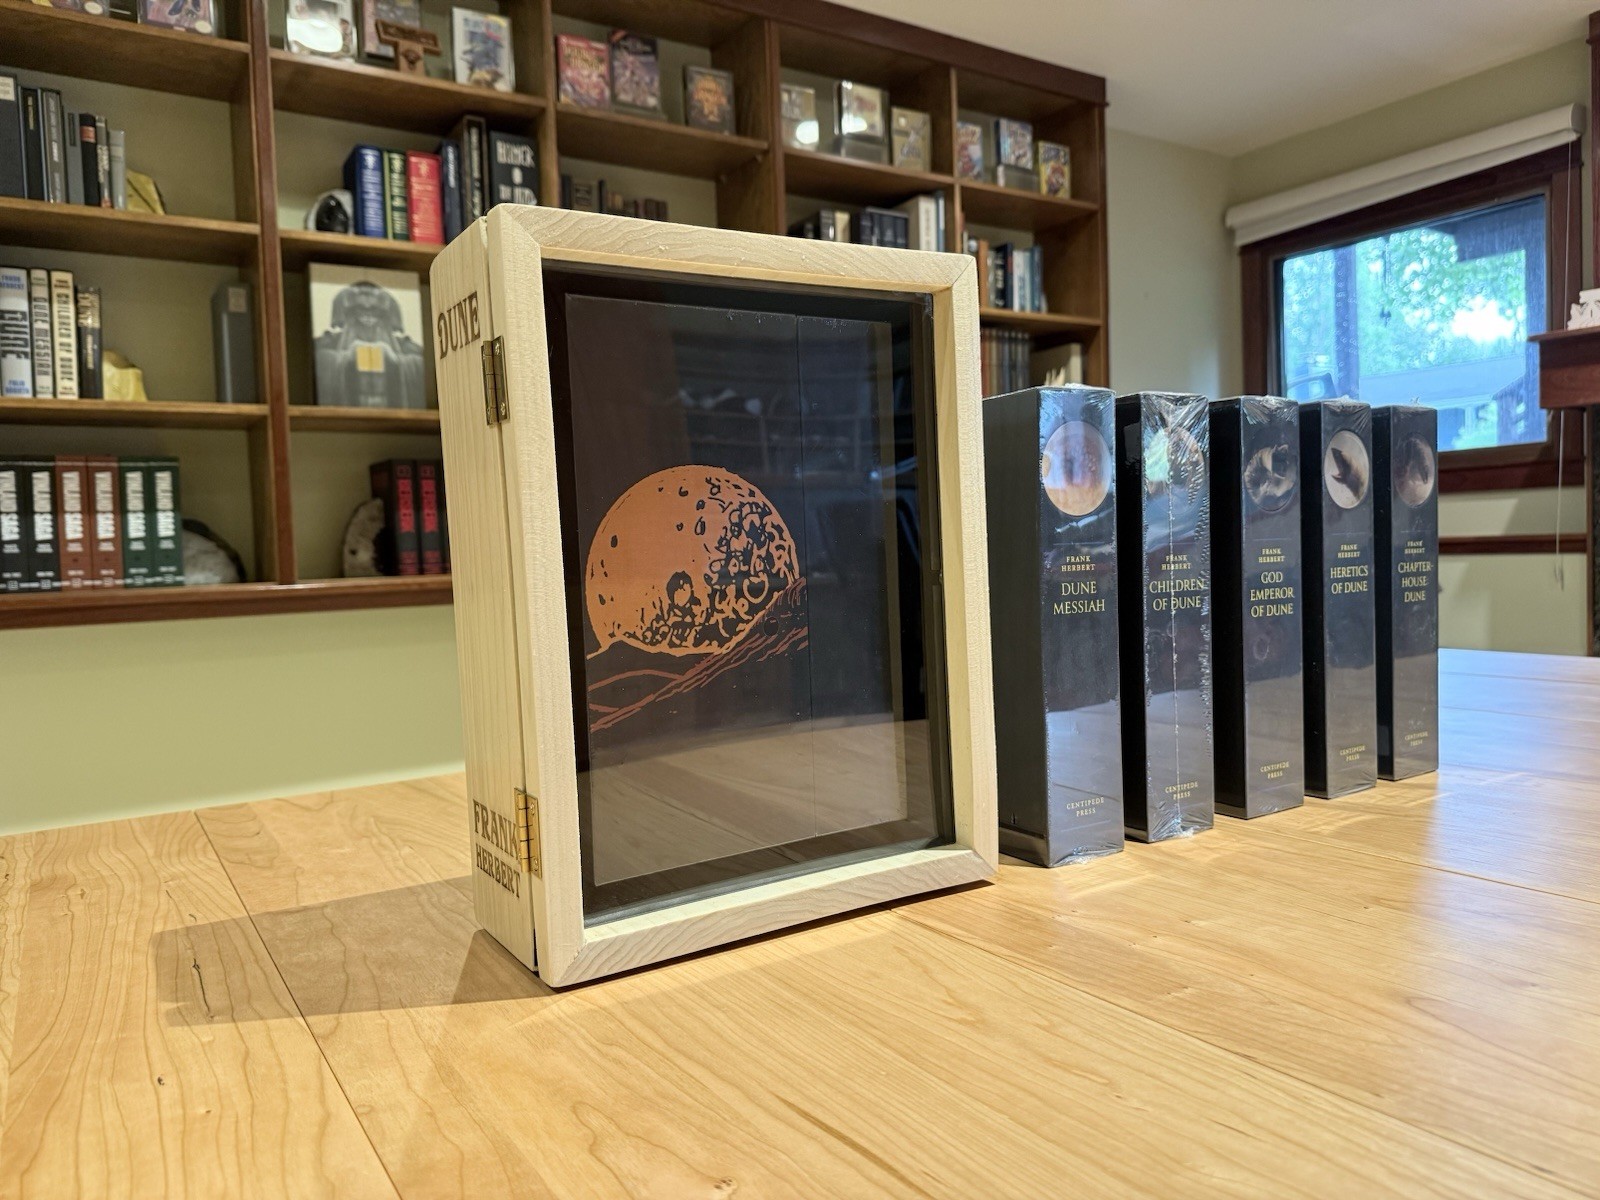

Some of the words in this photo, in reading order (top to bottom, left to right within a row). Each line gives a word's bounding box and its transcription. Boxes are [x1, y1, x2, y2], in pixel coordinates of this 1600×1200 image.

[438, 291, 481, 359] DUNE
[1166, 554, 1188, 562] FRANK
[1061, 564, 1096, 572] HERBERT
[1162, 562, 1192, 570] HERBERT
[1330, 565, 1368, 578] HERETICS
[1260, 572, 1283, 584] GOD
[1061, 581, 1097, 596] DUNE
[1149, 578, 1205, 594] CHILDREN
[1331, 582, 1344, 594] OF
[1344, 580, 1368, 593] DUNE
[1250, 587, 1294, 601] EMPEROR
[1404, 590, 1426, 602] DUNE
[1053, 598, 1106, 615] MESSIAH
[1152, 598, 1168, 612] OF
[1171, 596, 1202, 610] DUNE
[1250, 606, 1264, 618] OF
[1266, 603, 1294, 616] DUNE
[1340, 746, 1366, 756] CENTIPEDE
[1346, 754, 1360, 762] PRESS
[1260, 762, 1290, 773] CENTIPEDE
[1268, 770, 1283, 780] PRESS
[1165, 781, 1199, 794] CENTIPEDE
[1172, 790, 1191, 800] PRESS
[1066, 796, 1105, 810] CENTIPEDE
[1076, 807, 1096, 818] PRESS
[472, 799, 519, 861] FRANK
[475, 843, 520, 899] HERBERT
